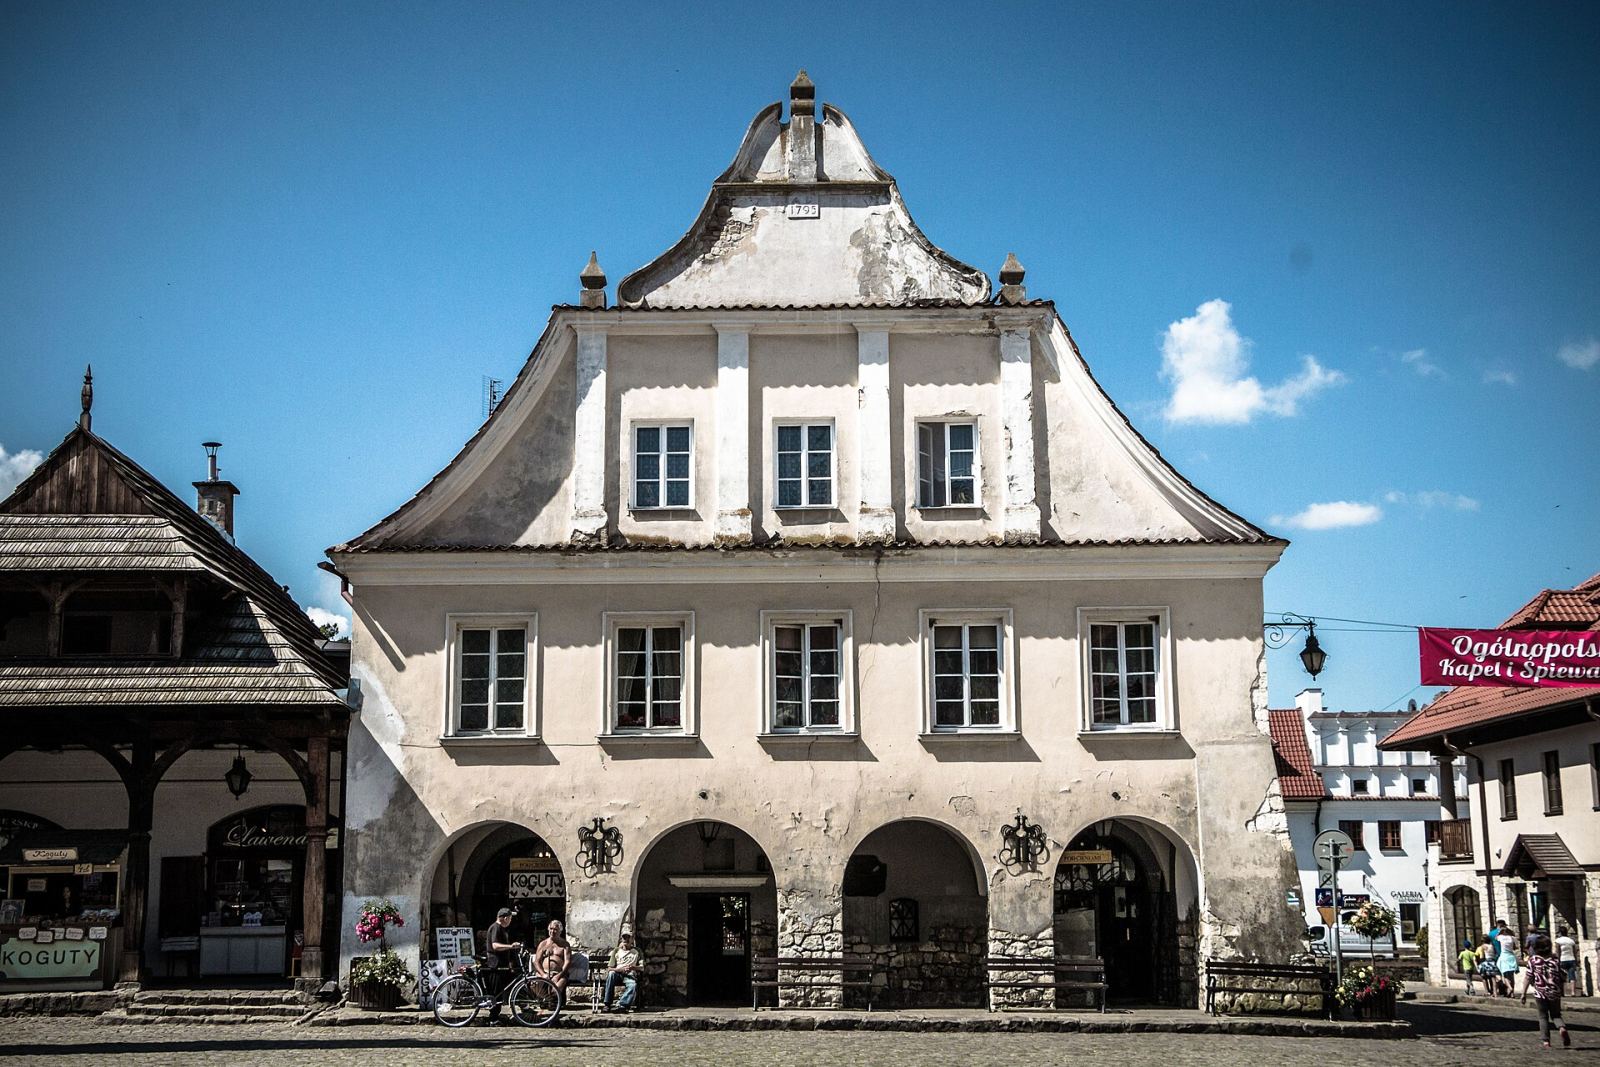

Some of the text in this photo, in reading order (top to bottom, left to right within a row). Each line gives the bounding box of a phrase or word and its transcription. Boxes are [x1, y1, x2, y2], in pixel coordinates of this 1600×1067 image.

[790, 205, 817, 215] 1795
[1451, 635, 1600, 663] Ogólnopols
[1439, 658, 1501, 681] Kapel
[1506, 661, 1514, 677] i
[510, 874, 564, 888] KOGUTY
[1390, 890, 1422, 898] GALERIA
[3, 950, 96, 965] KOGUTY
